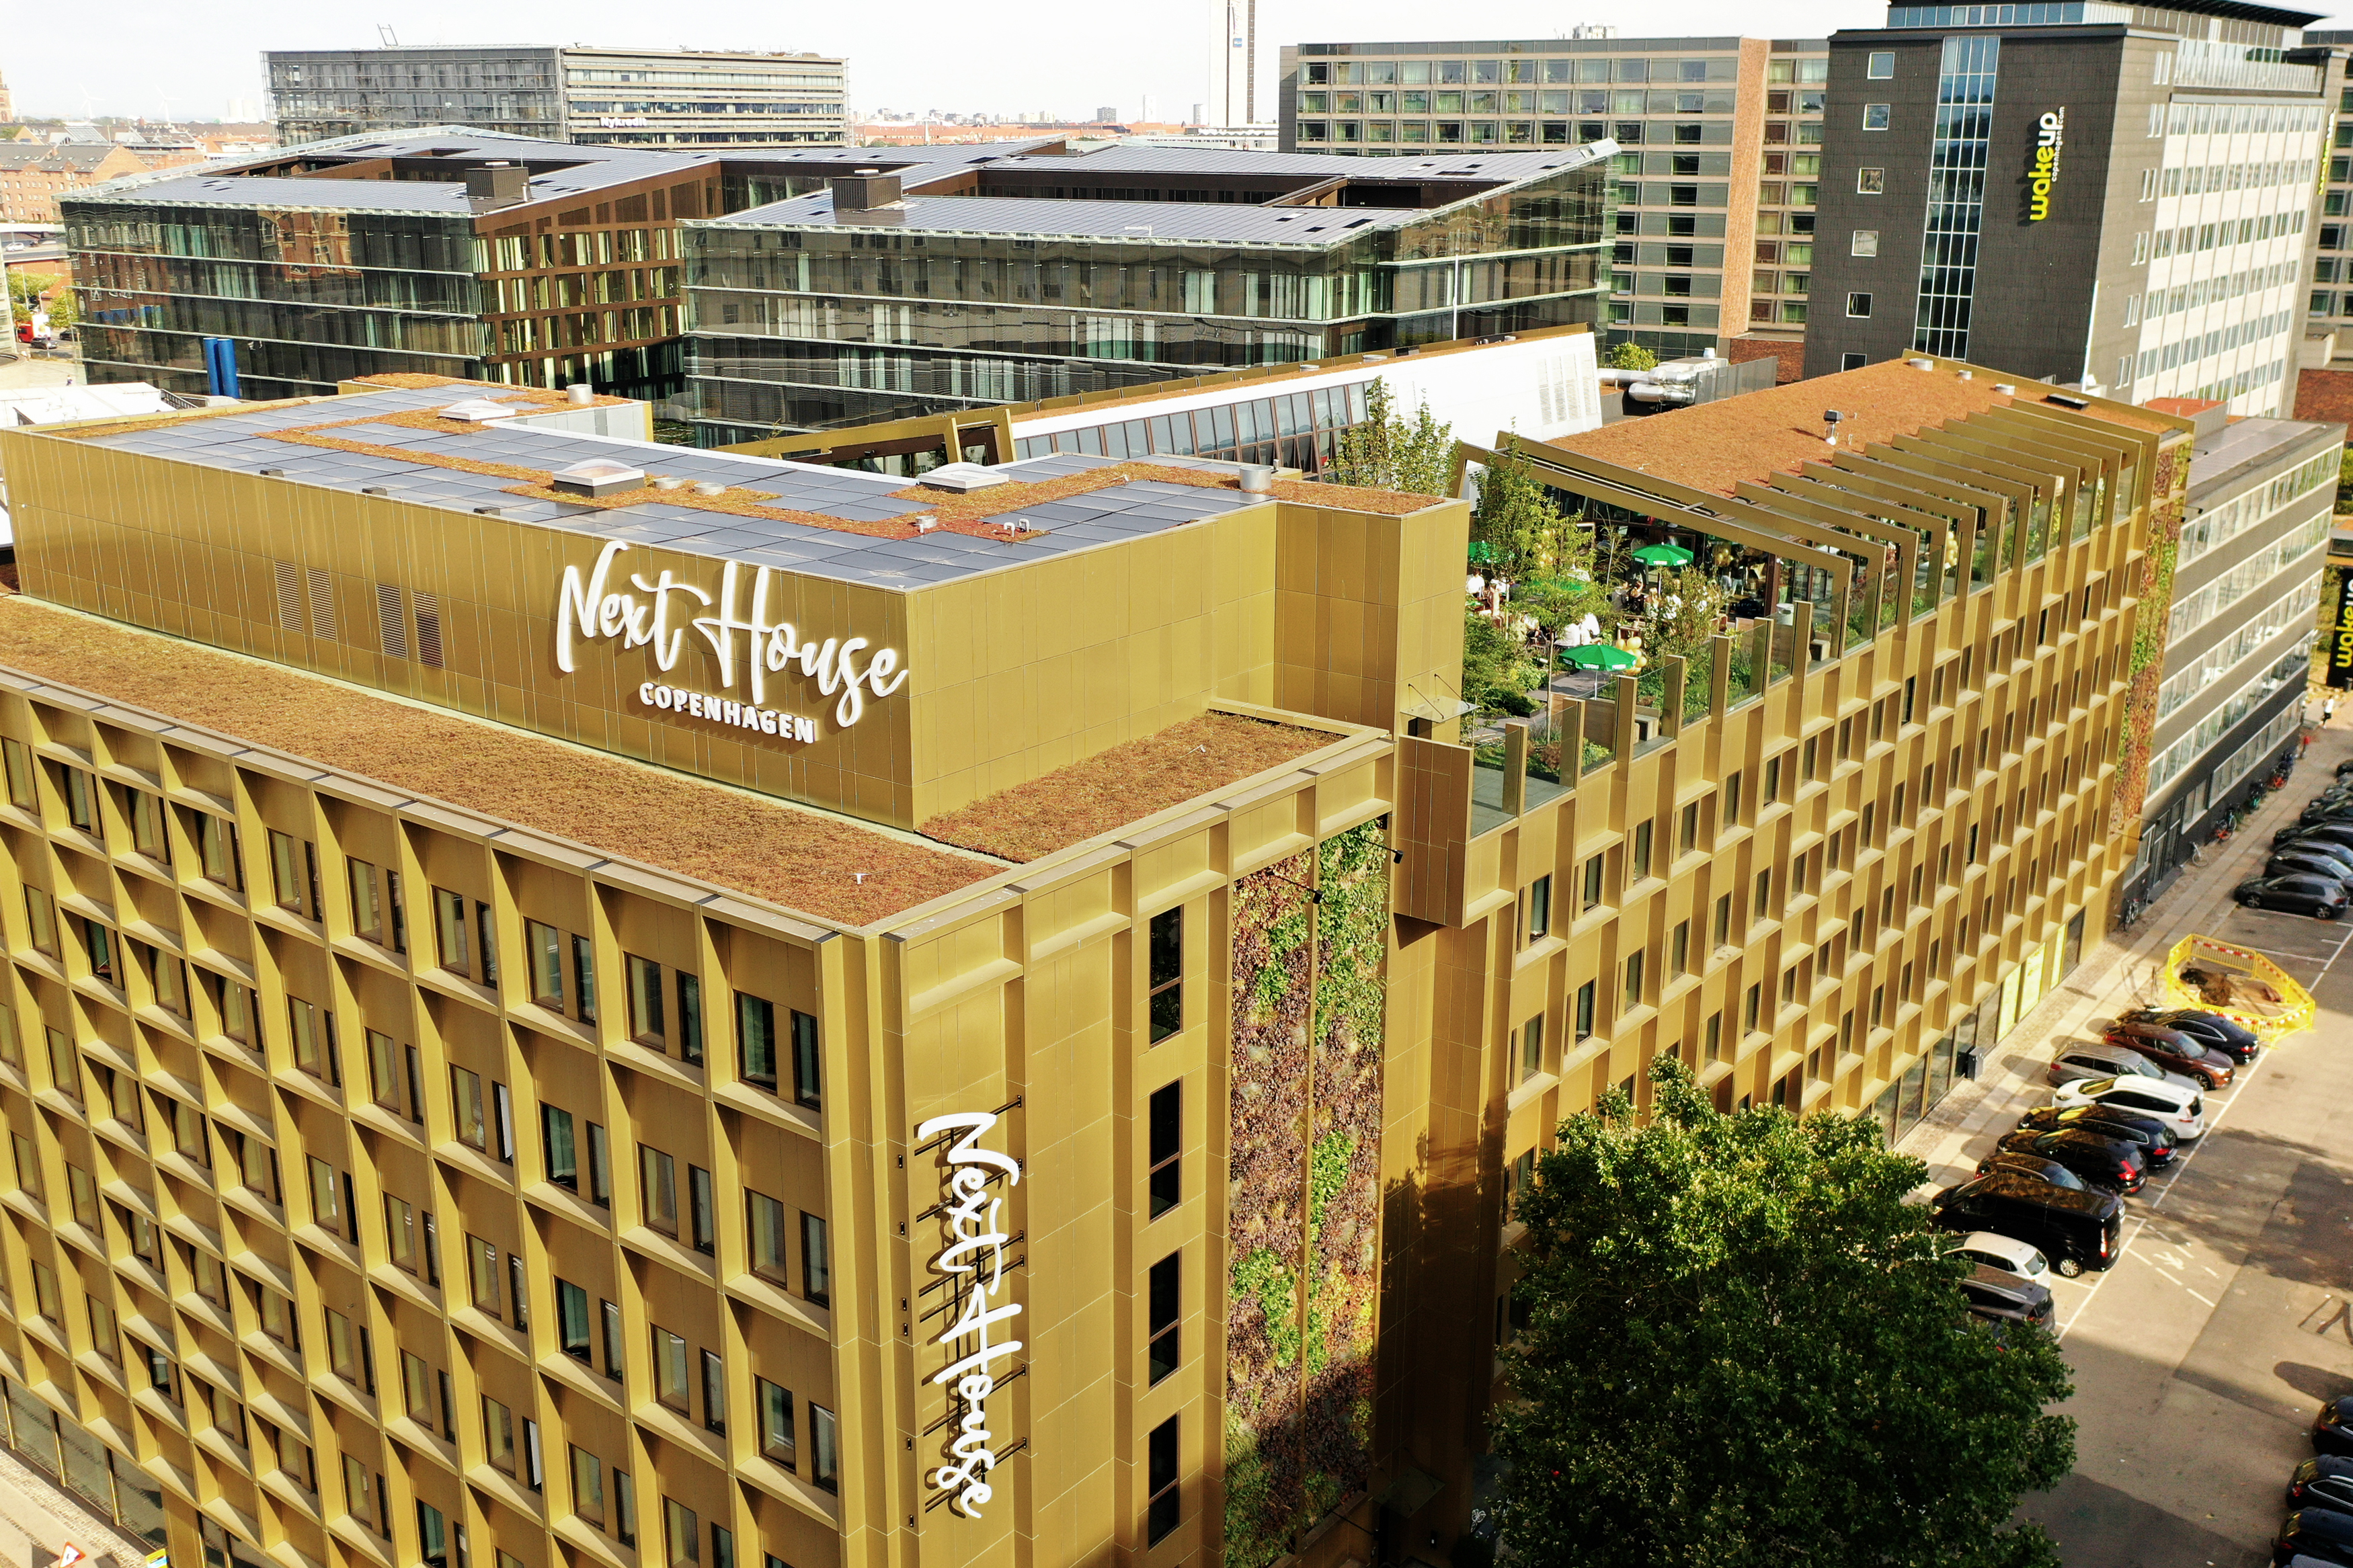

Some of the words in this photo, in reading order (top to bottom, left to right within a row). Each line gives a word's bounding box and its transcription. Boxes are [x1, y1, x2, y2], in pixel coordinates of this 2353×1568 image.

[600, 116, 647, 128] Nykredit
[2028, 112, 2063, 220] wakeup
[556, 540, 711, 673] Next
[691, 560, 908, 728] House
[639, 682, 815, 743] COPENHAGEN
[918, 1112, 1020, 1296] Next
[933, 1282, 1023, 1519] House
